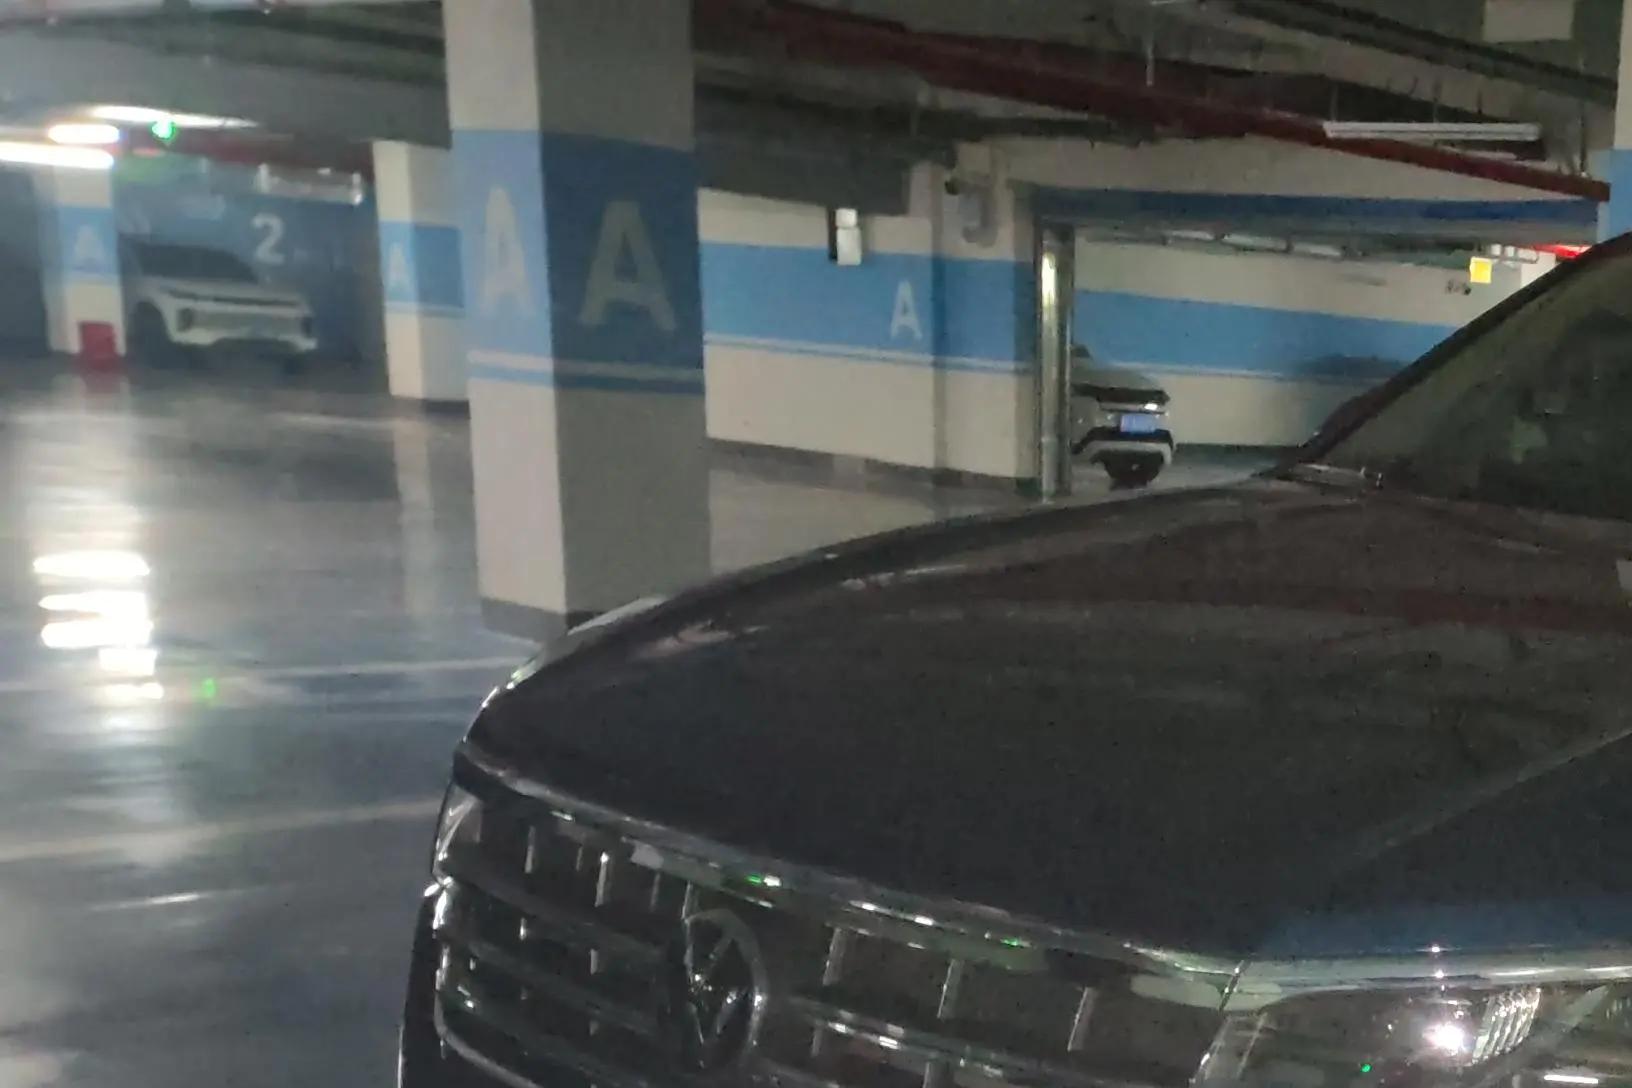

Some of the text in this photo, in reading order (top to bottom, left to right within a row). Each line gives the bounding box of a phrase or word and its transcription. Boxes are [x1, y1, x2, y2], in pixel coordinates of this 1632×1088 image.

[251, 213, 285, 265] 2
[480, 184, 537, 318] A
[579, 199, 677, 331] A
[890, 279, 922, 339] A
